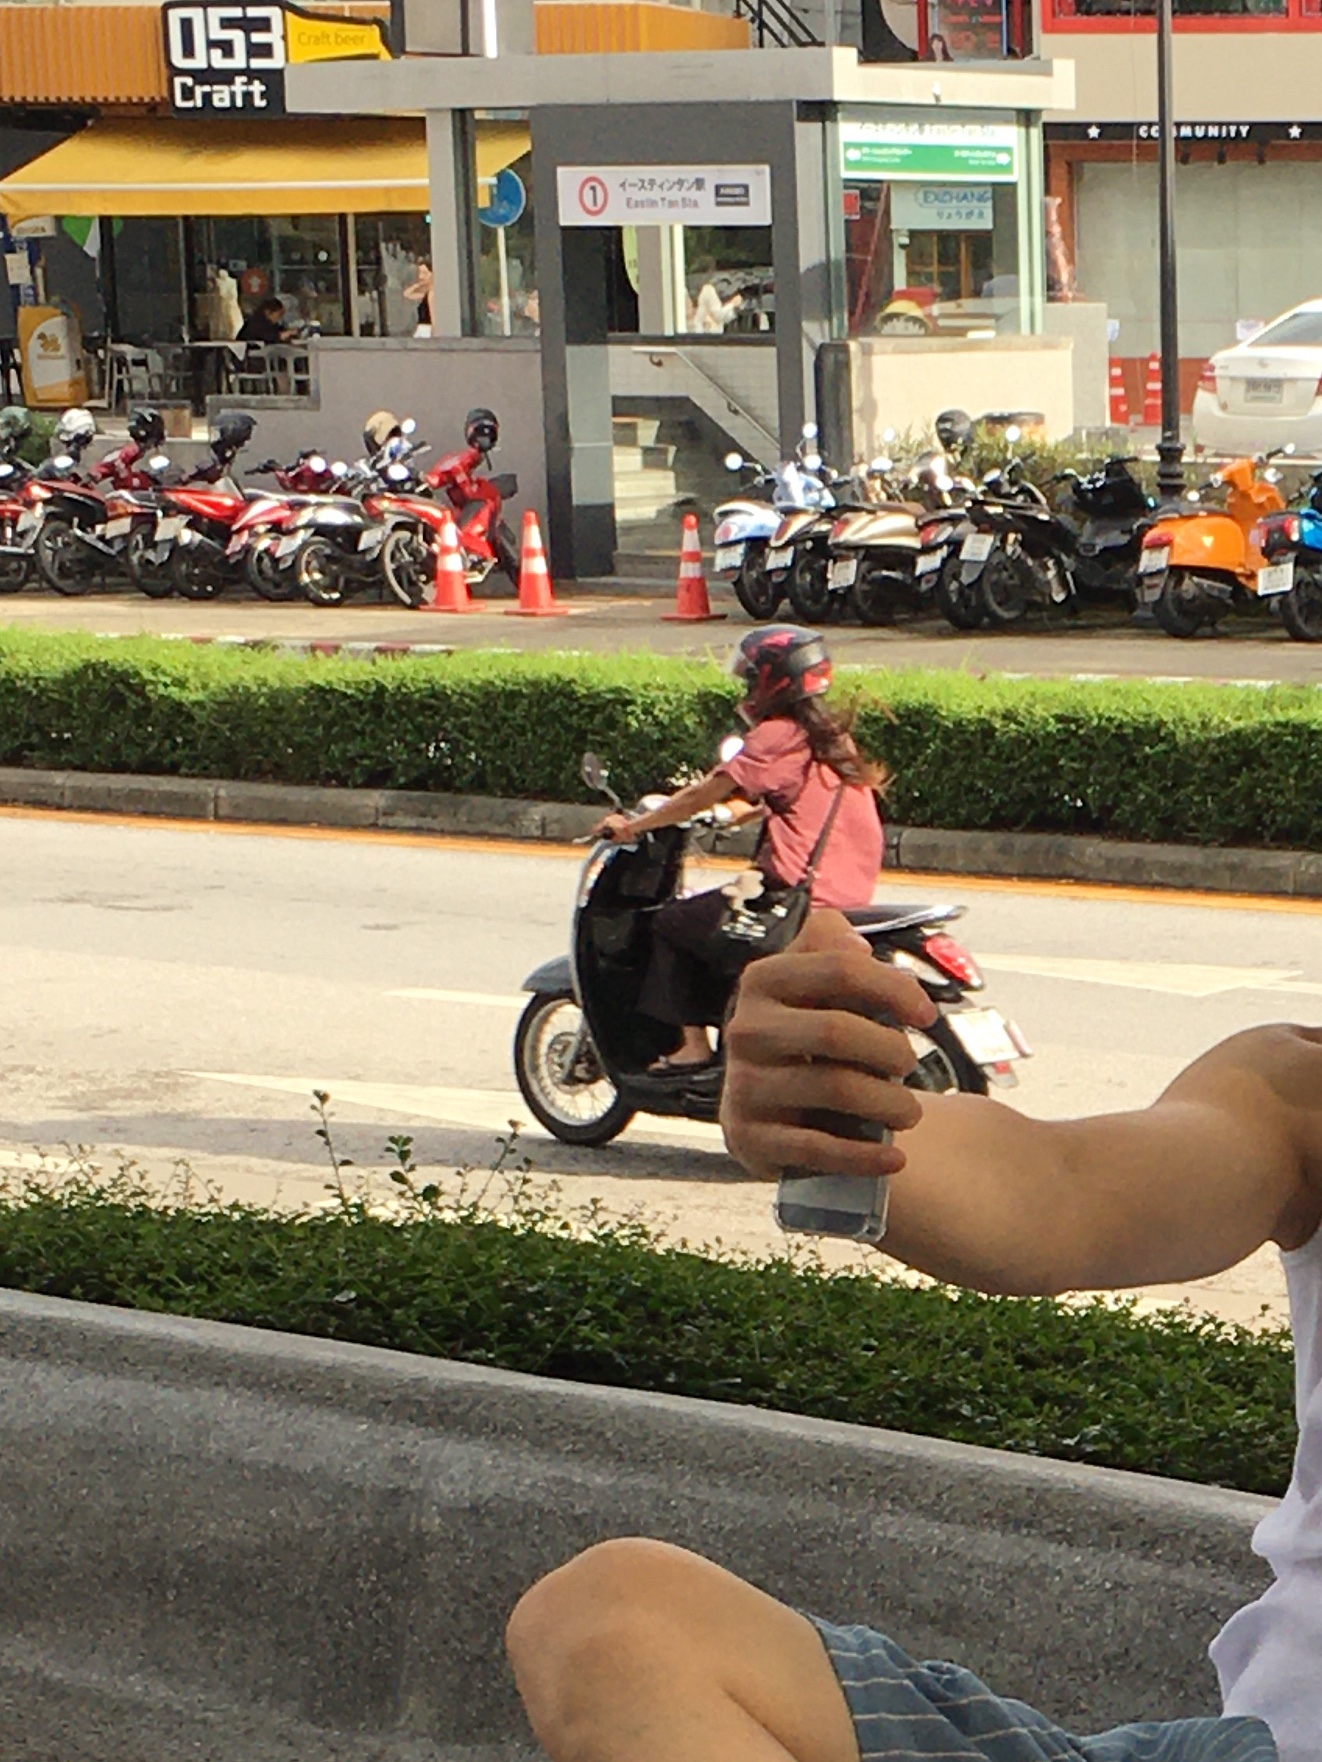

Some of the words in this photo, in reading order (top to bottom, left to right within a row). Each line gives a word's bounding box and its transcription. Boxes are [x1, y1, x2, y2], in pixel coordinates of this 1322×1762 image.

[168, 6, 285, 69] 053
[298, 31, 331, 46] Craft
[334, 31, 366, 46] beer
[173, 76, 268, 108] Craft
[1138, 125, 1250, 138] COMUNITY
